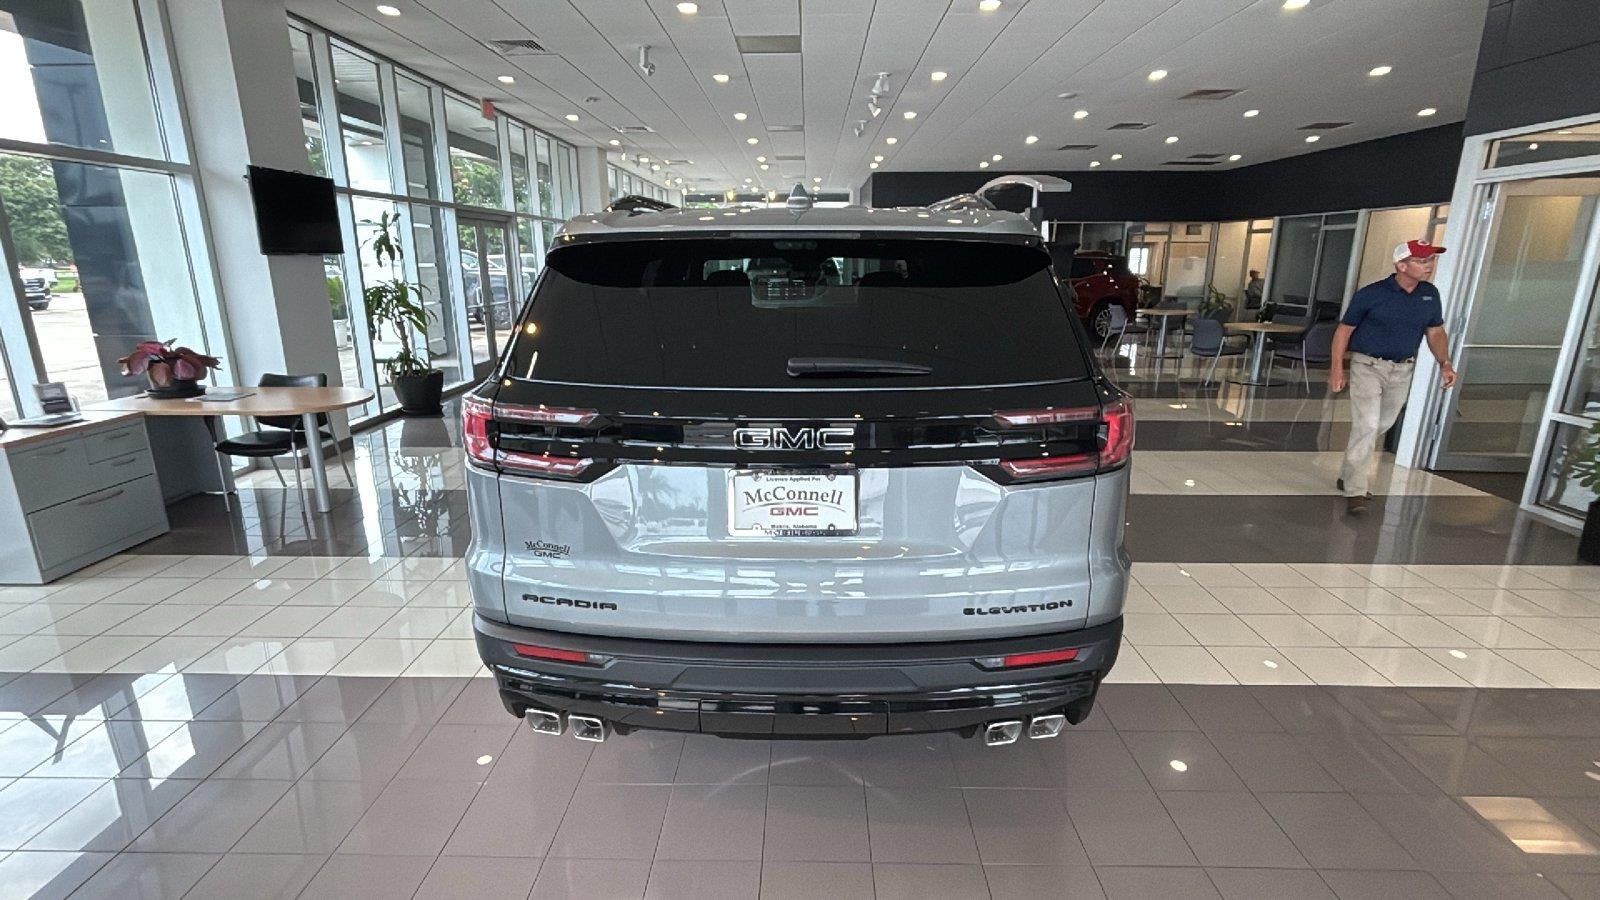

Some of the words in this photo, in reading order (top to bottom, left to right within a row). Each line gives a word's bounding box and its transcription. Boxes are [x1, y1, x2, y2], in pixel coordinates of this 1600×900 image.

[733, 427, 854, 450] GMC
[744, 486, 843, 505] McConnell
[770, 507, 818, 516] GMC
[525, 540, 570, 555] McConnell
[534, 550, 561, 559] GMC
[522, 593, 617, 610] ACADIA
[963, 600, 1073, 616] ELEVATION
